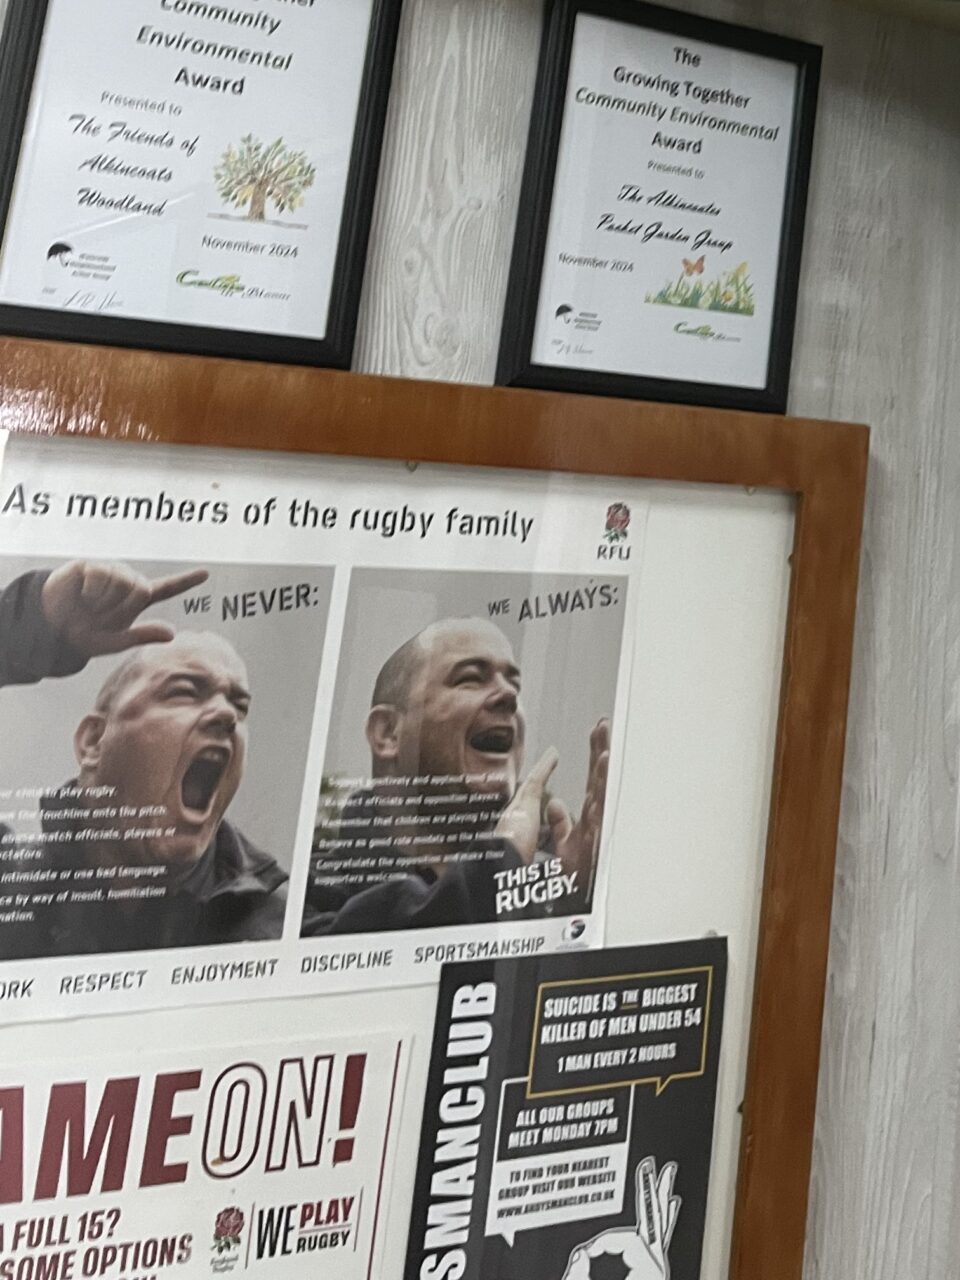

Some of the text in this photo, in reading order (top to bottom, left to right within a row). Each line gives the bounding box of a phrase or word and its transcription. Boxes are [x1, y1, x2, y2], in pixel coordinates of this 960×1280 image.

[136, 24, 294, 72] Environmental
[673, 47, 701, 67] The
[174, 66, 246, 96] Award
[613, 66, 752, 109] Growing Together
[100, 90, 183, 117] Presented to
[575, 86, 781, 141] Community Environmental
[68, 113, 200, 158] The Friends of
[652, 131, 703, 154] Award
[77, 186, 168, 216] Woodland
[617, 184, 644, 202] The
[201, 235, 299, 259] November 2024
[558, 252, 635, 272] November 2024
[1, 482, 534, 543] As members of the rugby family
[597, 545, 631, 561] RFU
[183, 583, 319, 621] WE NEVER:
[488, 584, 618, 623] WE ALWAYS:
[60, 786, 83, 799] play
[119, 806, 137, 818] the
[494, 857, 562, 890] THIS IS
[496, 871, 578, 914] RUGBY.
[59, 969, 147, 995] RESPECT
[171, 958, 280, 986] ENJOYMENT
[300, 949, 393, 975] DISCIPLINE
[414, 936, 546, 964] SPORTSMANSHIP
[544, 983, 698, 1018] SUICIDE IS THE BIGGEST
[541, 1007, 702, 1045] KILLER OF MEN UNDER 54
[557, 1043, 677, 1073] 1 MAN EVERY 2 HOURS
[516, 1098, 615, 1127] ALL OUR GROUPS
[508, 1117, 619, 1149] MEET MONDAY 7PM
[510, 1170, 521, 1184] TO
[532, 1180, 556, 1195] VISIT
[11, 1216, 70, 1252] FULL
[77, 1208, 122, 1244] 15?
[256, 1196, 355, 1260] WE PLAY
[296, 1230, 350, 1254] RUGBY
[0, 1233, 193, 1280] SOME OPTIONS
